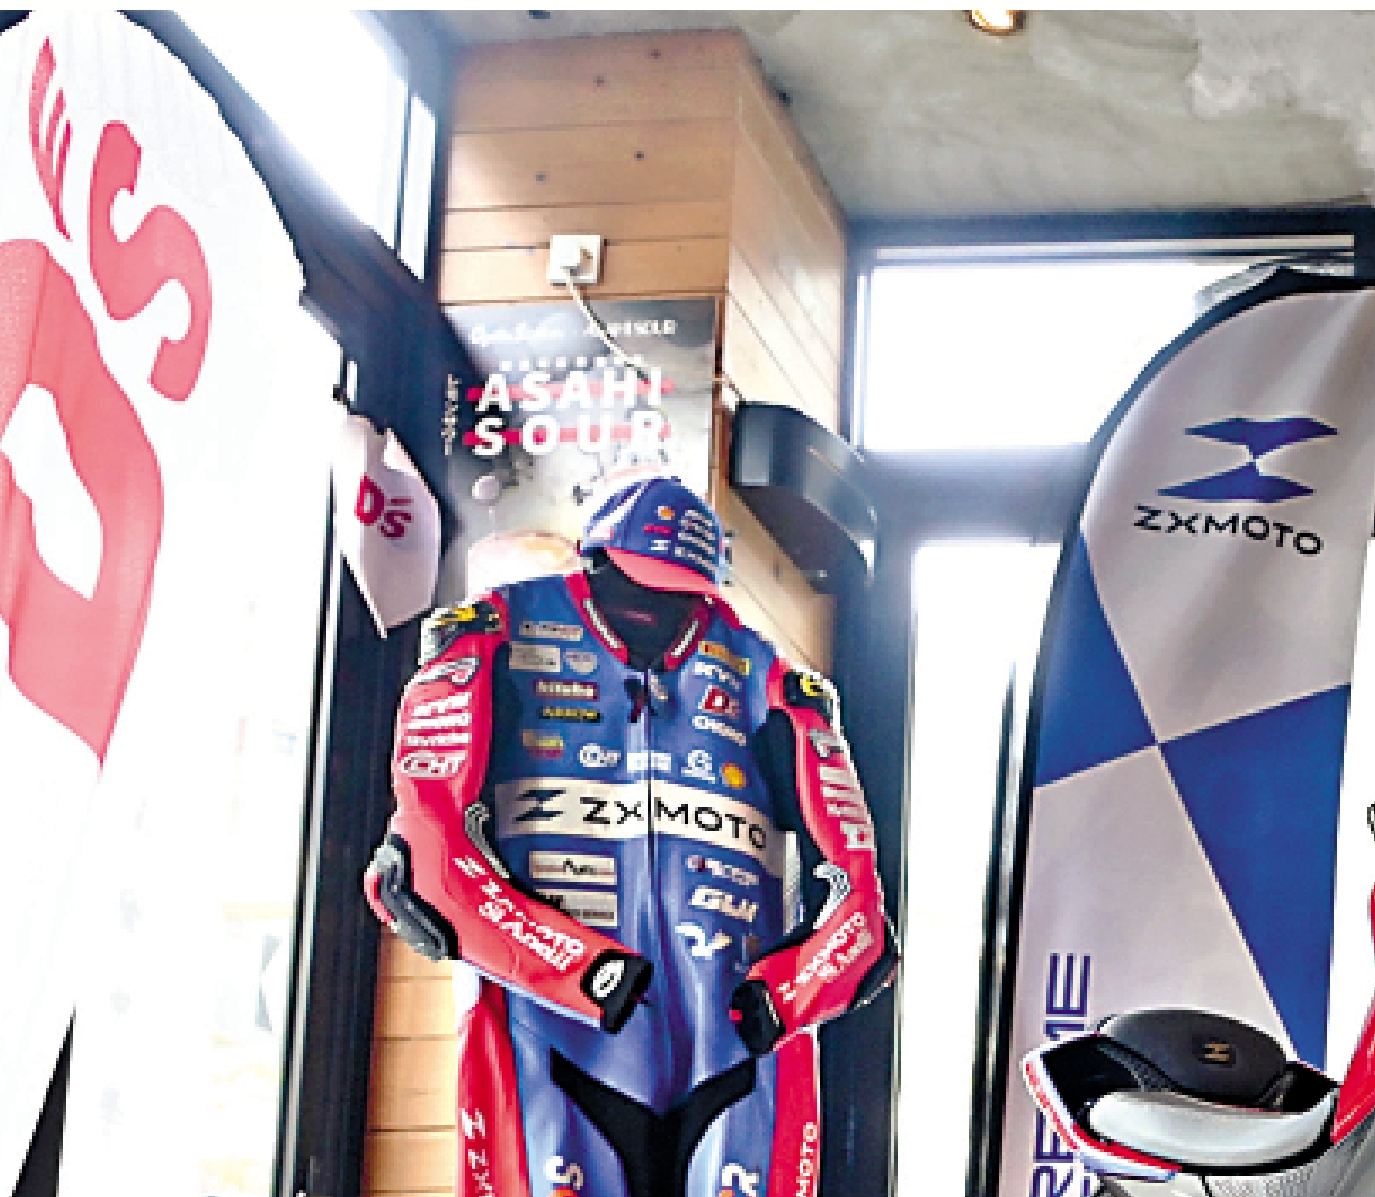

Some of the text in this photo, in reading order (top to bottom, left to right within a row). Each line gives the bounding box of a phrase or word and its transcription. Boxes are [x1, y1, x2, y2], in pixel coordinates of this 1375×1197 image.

[474, 366, 663, 412] ASAHI
[472, 410, 667, 457] SOUR
[1132, 503, 1324, 556] ZXMOTO
[579, 796, 768, 849] ZXMOTO
